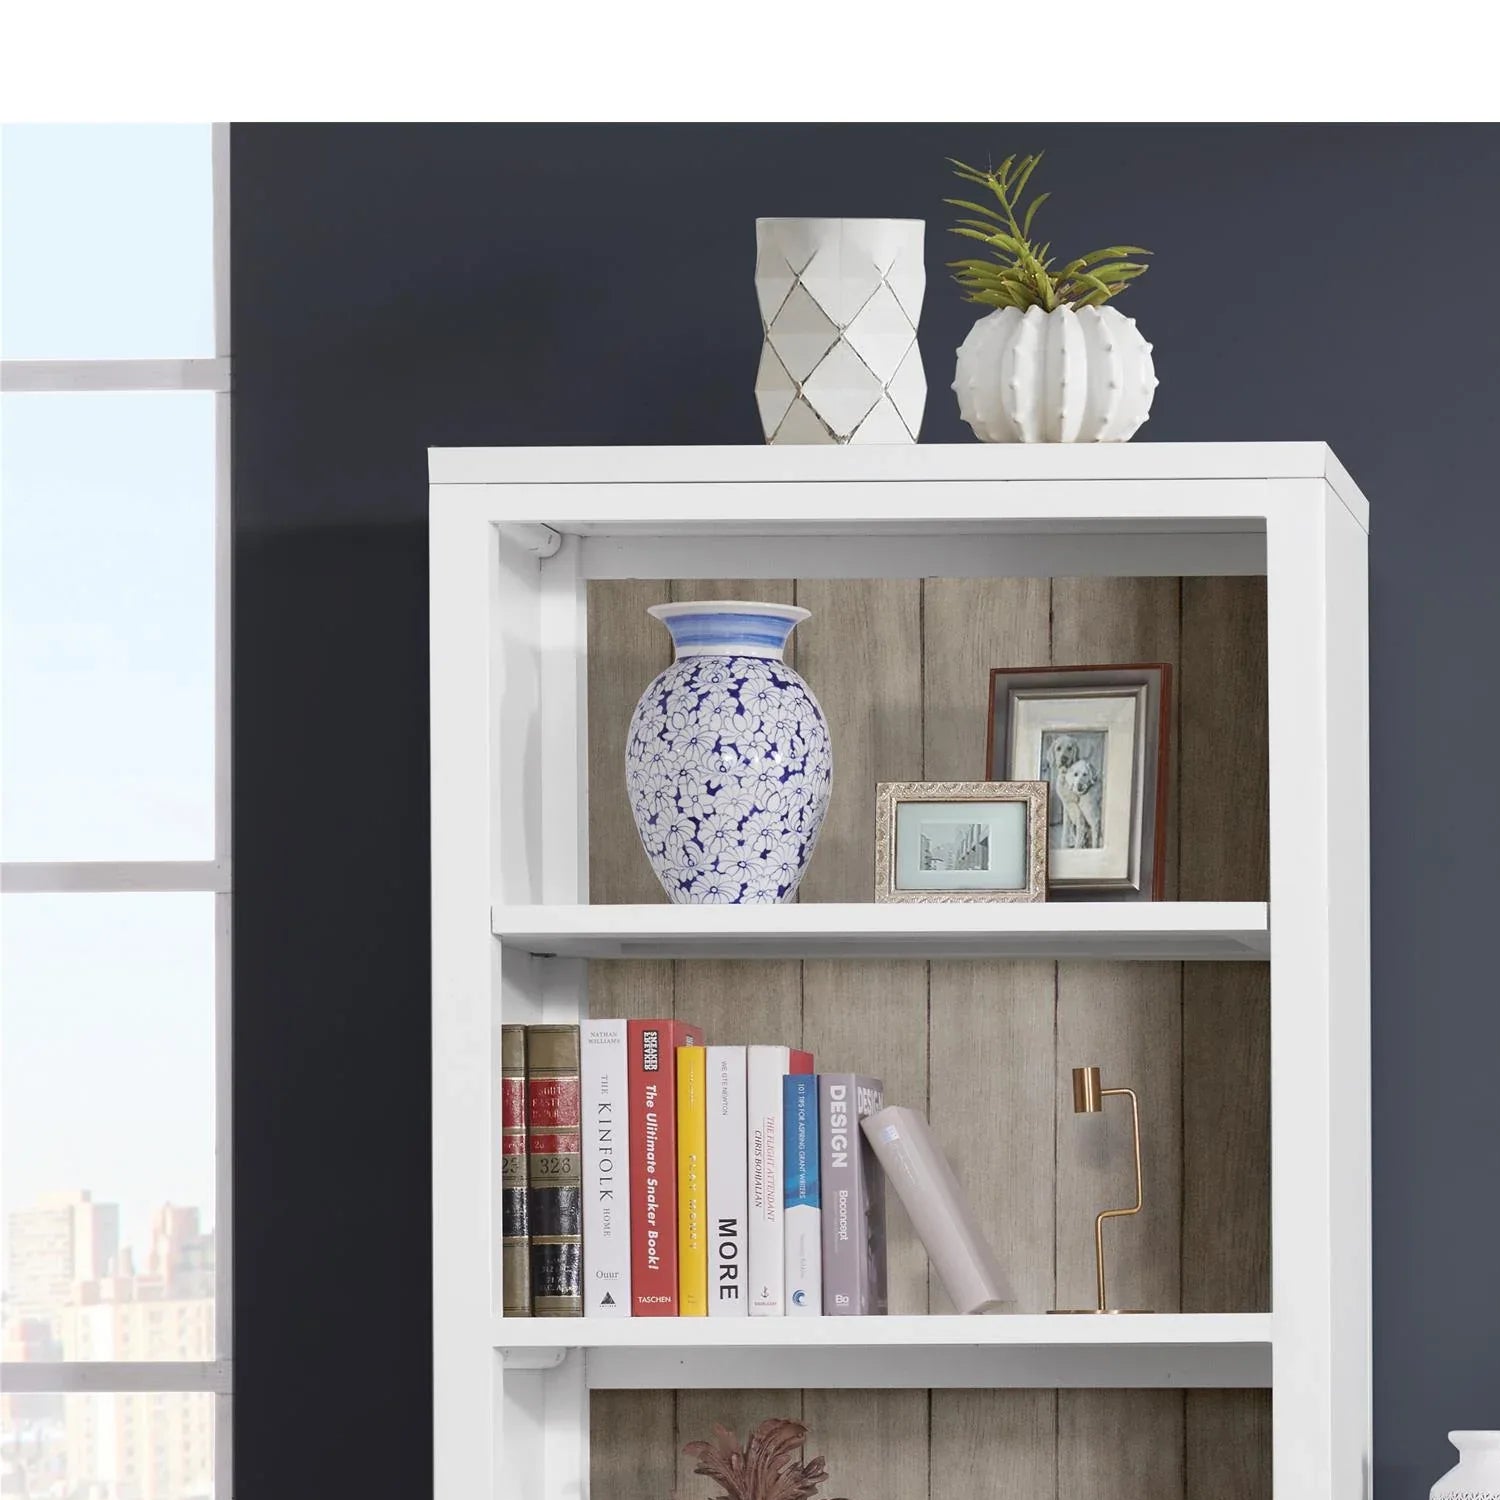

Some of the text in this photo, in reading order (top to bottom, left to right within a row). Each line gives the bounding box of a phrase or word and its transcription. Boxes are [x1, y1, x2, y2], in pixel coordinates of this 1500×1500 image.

[645, 1084, 658, 1108] The
[754, 1130, 763, 1156] CHRIS
[830, 1085, 848, 1168] DESIGN
[540, 1157, 571, 1175] 326
[598, 1075, 614, 1237] THE KINFOLK HOME
[766, 1168, 775, 1222] ATTENDANT
[647, 1230, 660, 1270] Book!
[718, 1218, 738, 1300] MORE
[637, 1296, 671, 1304] TASCHEN
[835, 1294, 849, 1304] Bo
